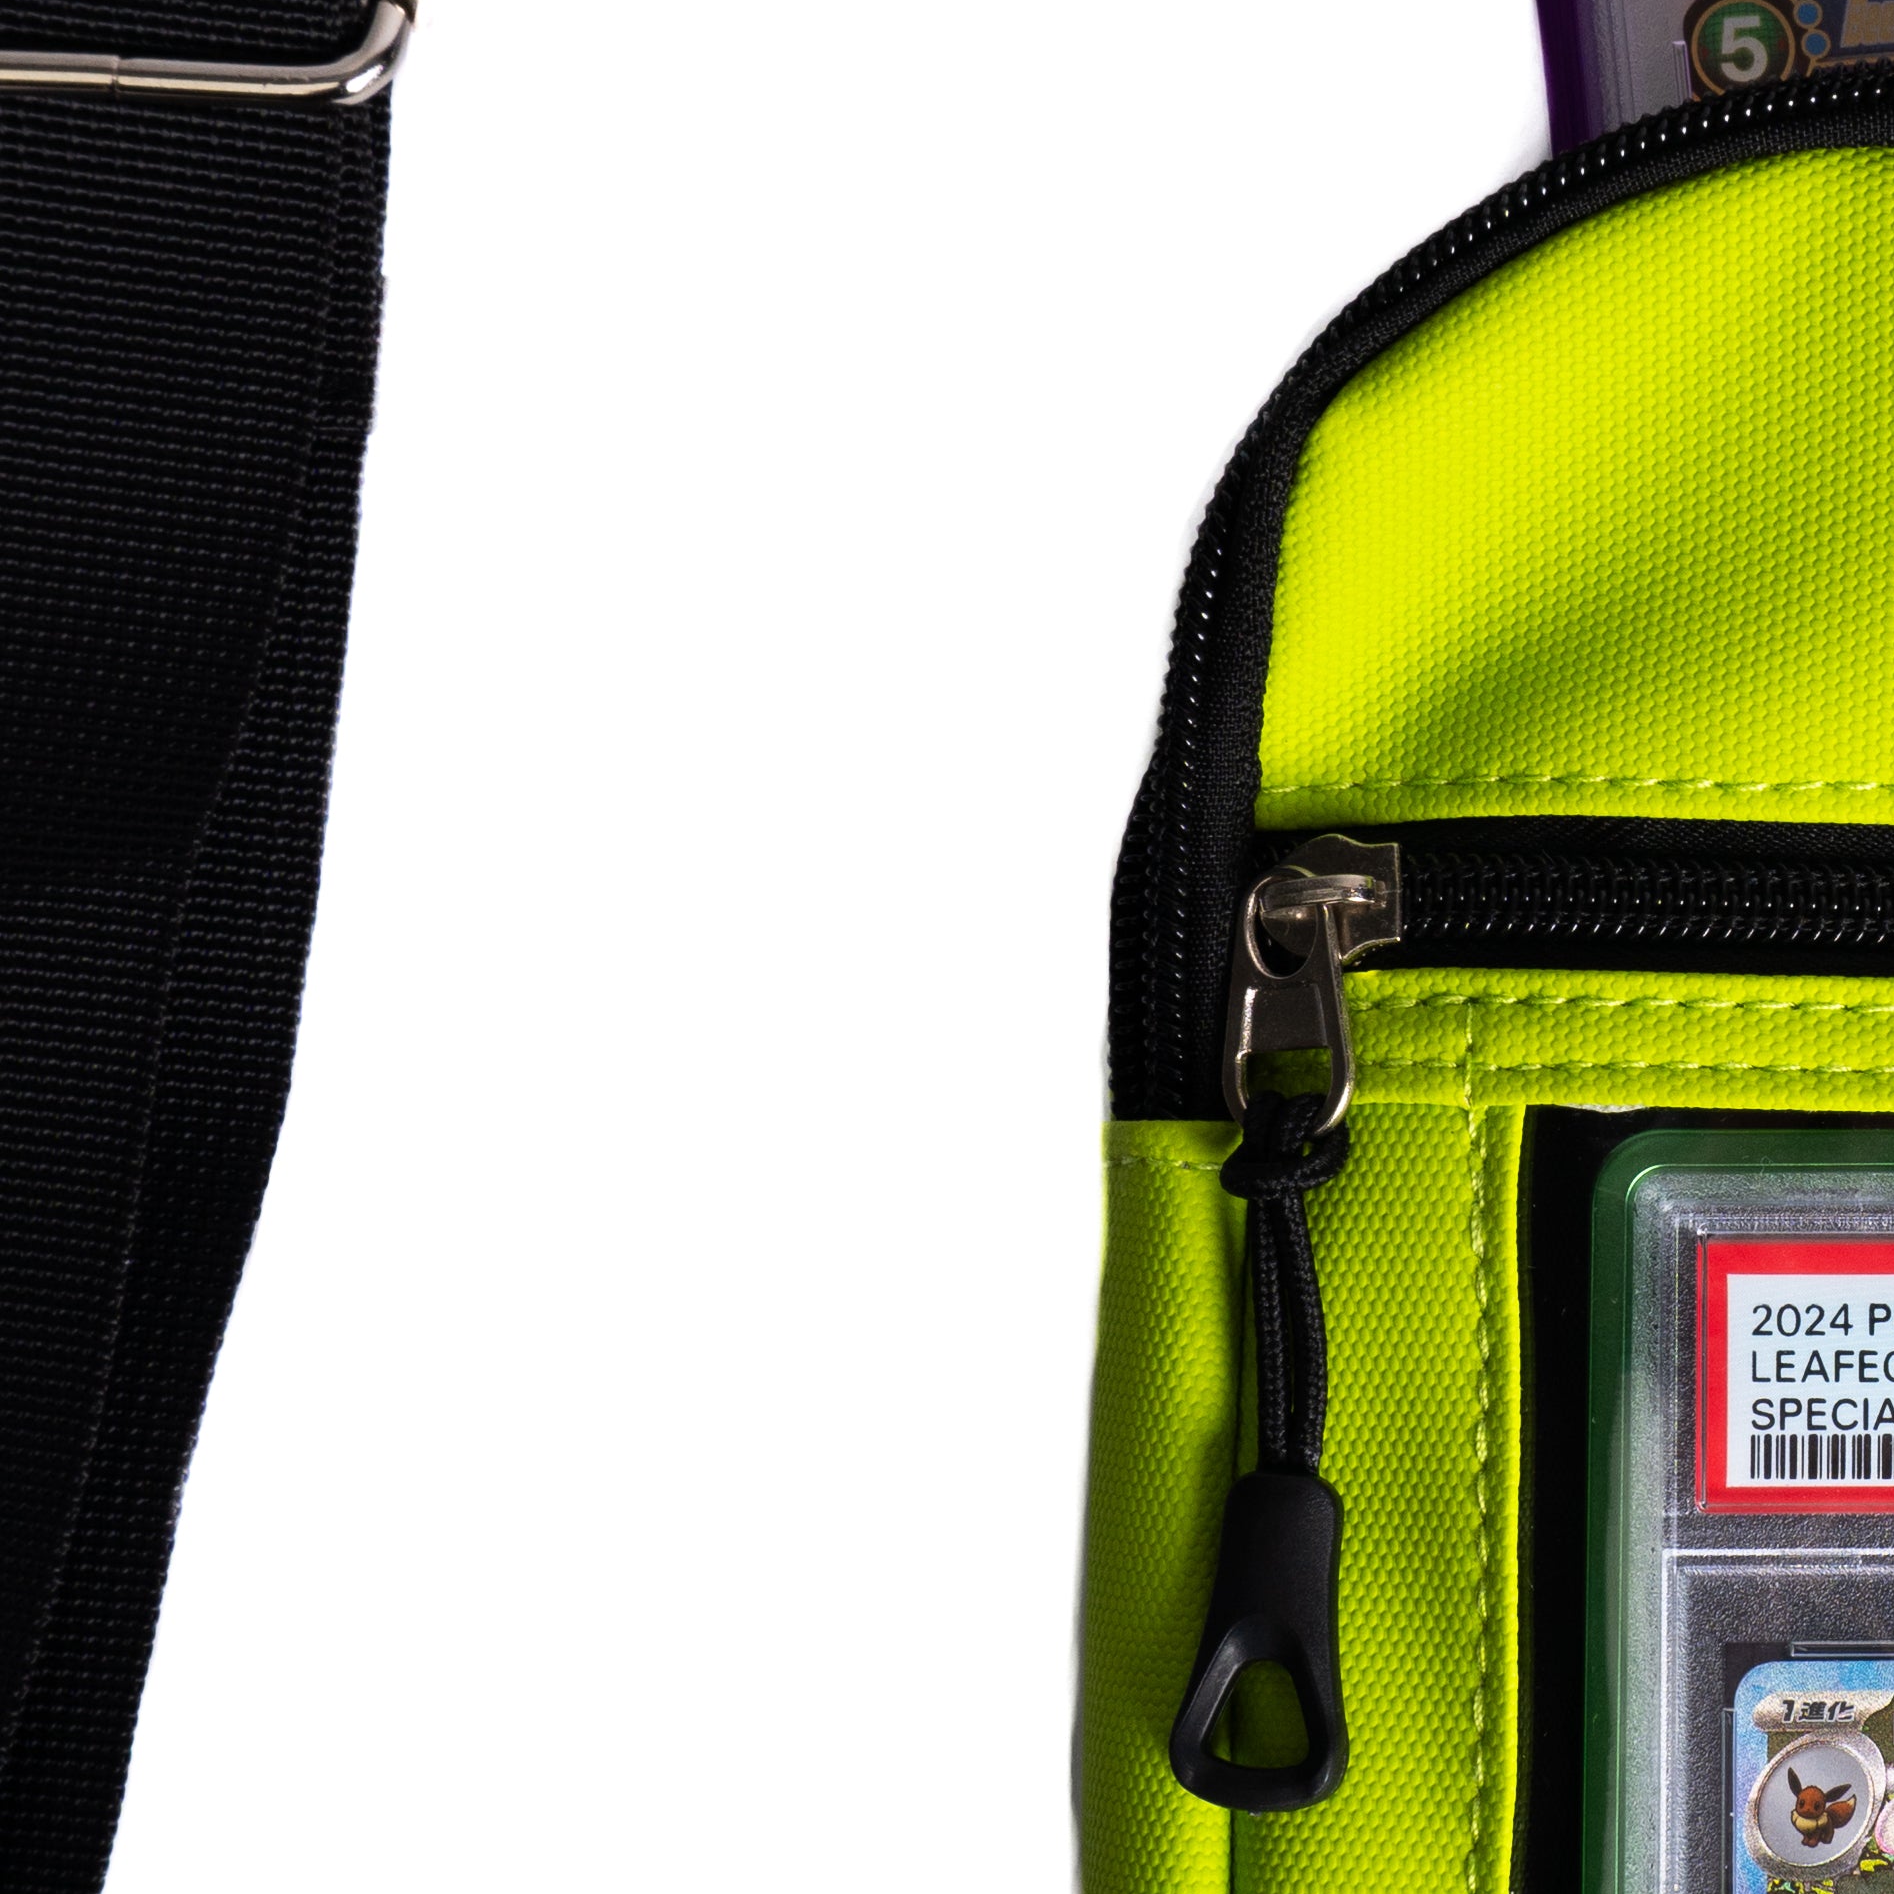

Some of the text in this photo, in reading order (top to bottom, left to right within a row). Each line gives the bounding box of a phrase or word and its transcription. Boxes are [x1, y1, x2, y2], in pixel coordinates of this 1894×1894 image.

[1719, 14, 1769, 83] 5
[1752, 1303, 1853, 1337] 2024
[1780, 1699, 1856, 1724] 1進化
